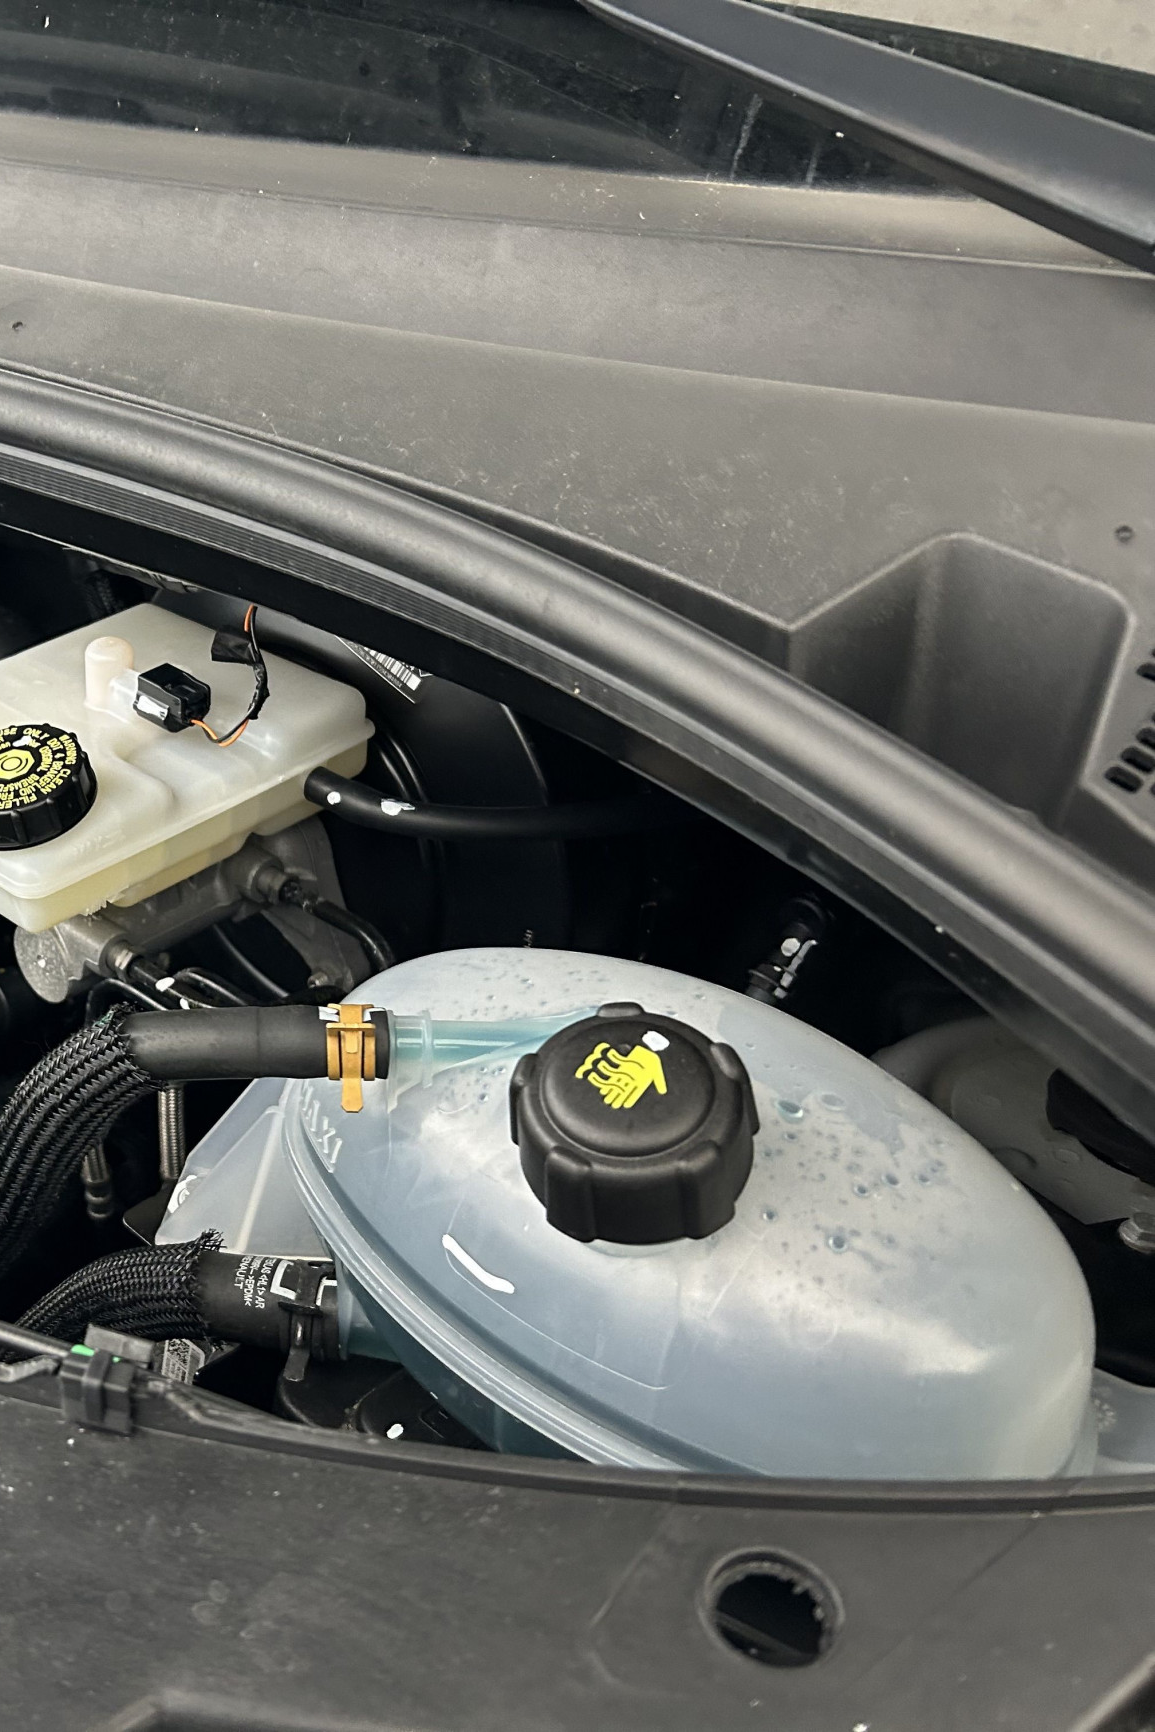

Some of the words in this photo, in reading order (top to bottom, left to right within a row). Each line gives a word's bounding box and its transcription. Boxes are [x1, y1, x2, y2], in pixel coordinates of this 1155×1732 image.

[23, 727, 50, 742] ONLY
[47, 737, 64, 753] DOT
[58, 734, 77, 765] WARNING
[19, 760, 63, 796] BRAKEFLUID
[42, 769, 71, 795] CLEAN
[255, 1295, 266, 1309] AR
